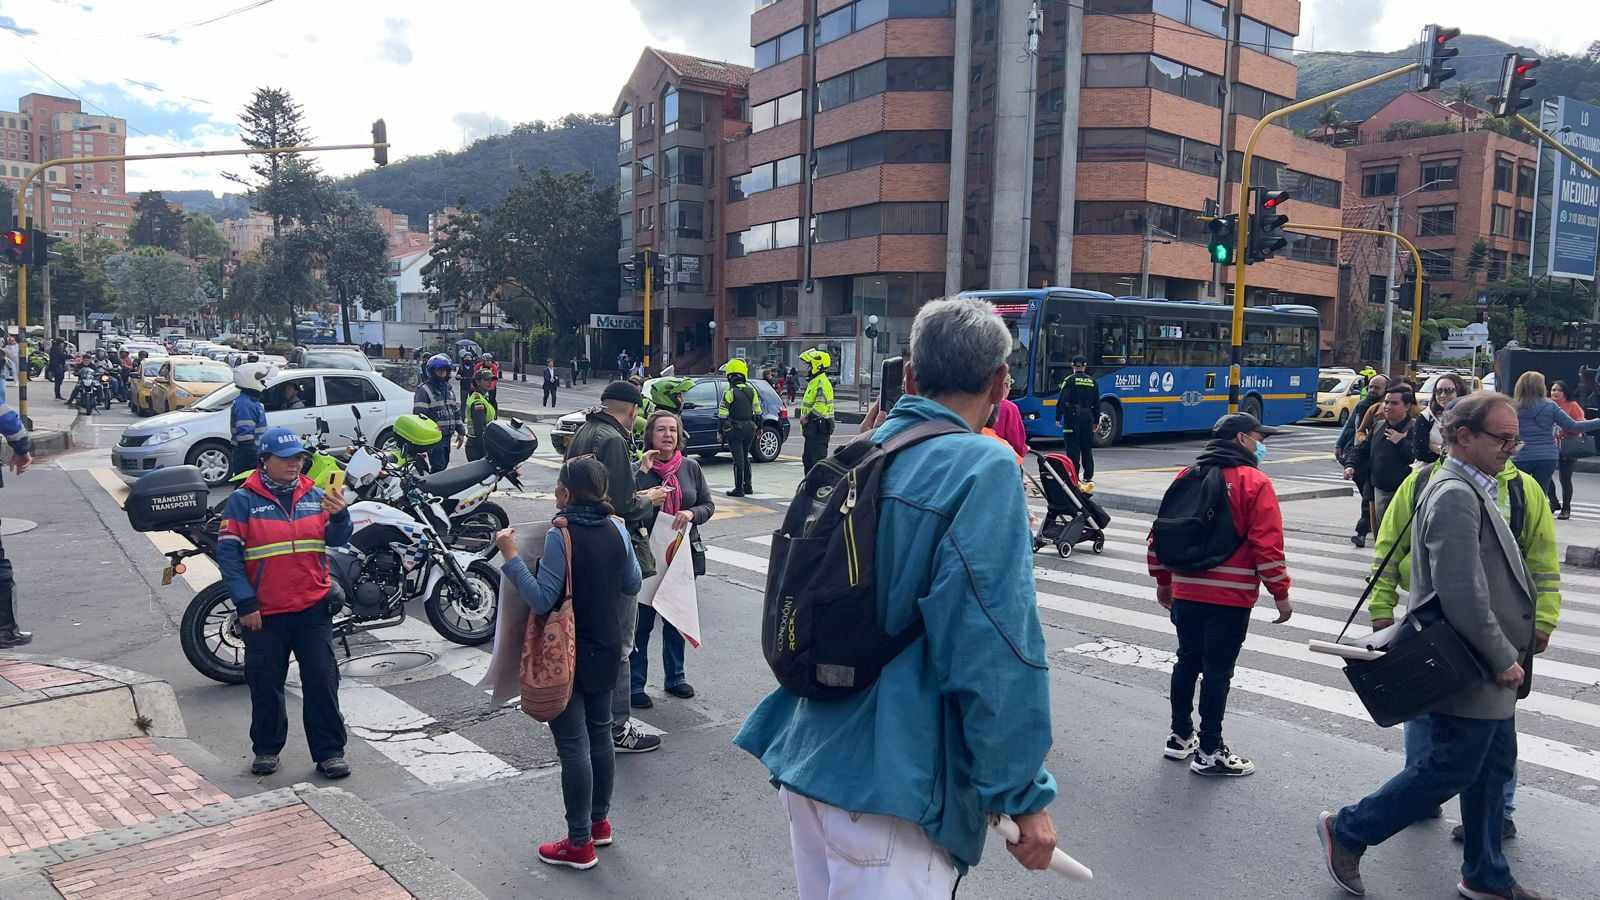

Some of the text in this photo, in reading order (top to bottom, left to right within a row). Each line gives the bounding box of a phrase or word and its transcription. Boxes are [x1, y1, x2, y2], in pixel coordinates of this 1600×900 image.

[1581, 111, 1589, 127] LO
[1562, 131, 1600, 152] CONSTRUIMO
[1561, 180, 1599, 207] MEDIDA!
[596, 315, 643, 328] Muran
[1225, 375, 1273, 388] TsMilenio
[151, 500, 198, 511] TRANSPORTE
[152, 494, 188, 505] TRÁNSITO
